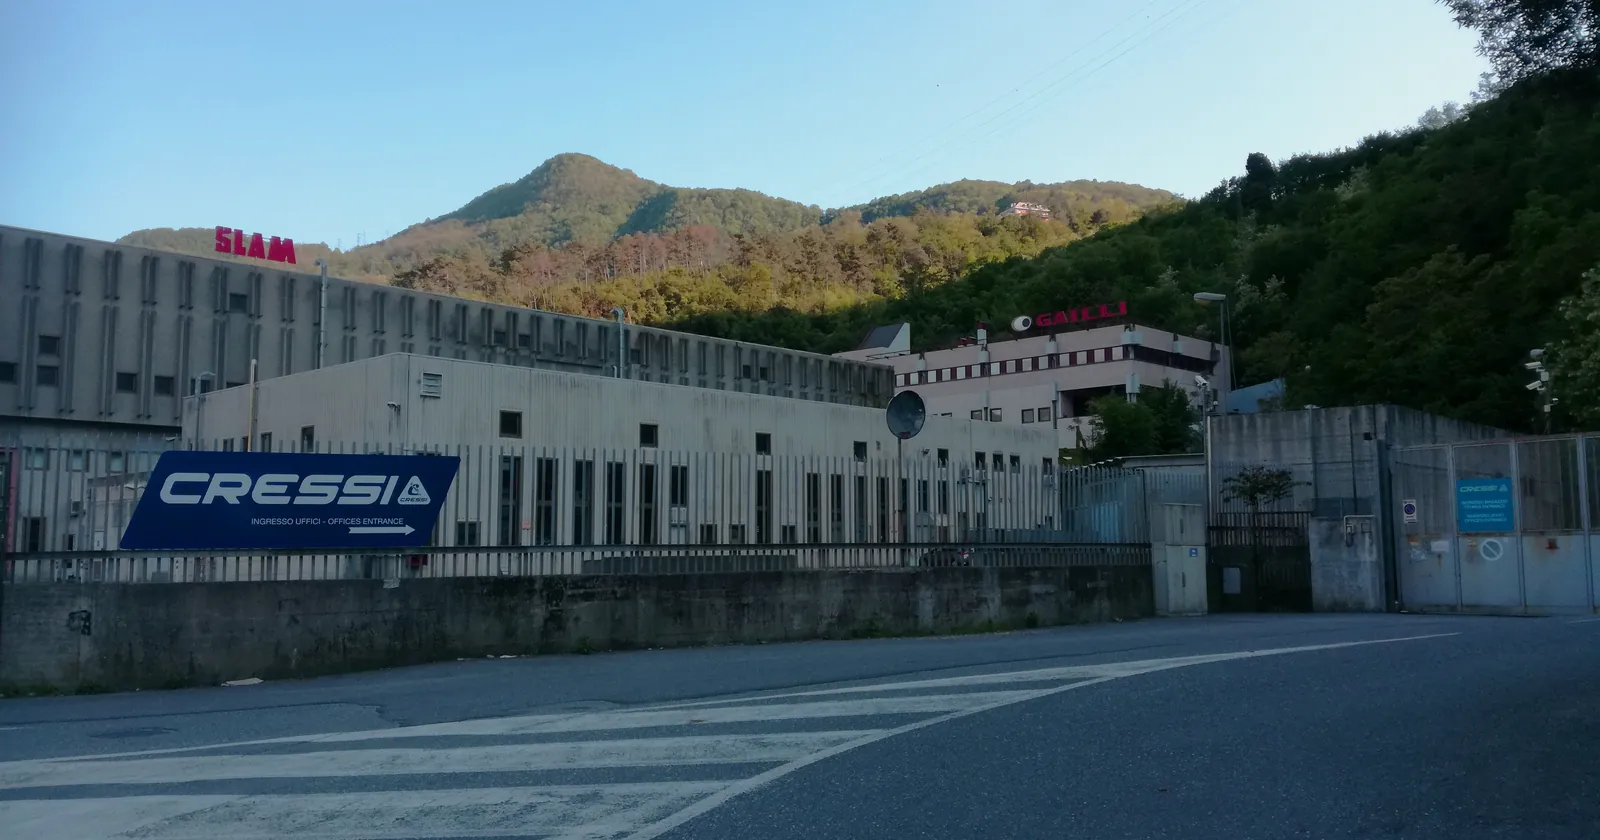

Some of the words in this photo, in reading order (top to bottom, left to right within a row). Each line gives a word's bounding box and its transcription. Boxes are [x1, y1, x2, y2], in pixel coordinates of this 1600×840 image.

[215, 225, 296, 265] SLAM
[160, 472, 399, 505] CRESSI
[251, 517, 294, 525] INGRESSO
[295, 517, 321, 525] UFFICI
[328, 517, 361, 525] OFFICES
[363, 517, 404, 525] ENTRANCE
